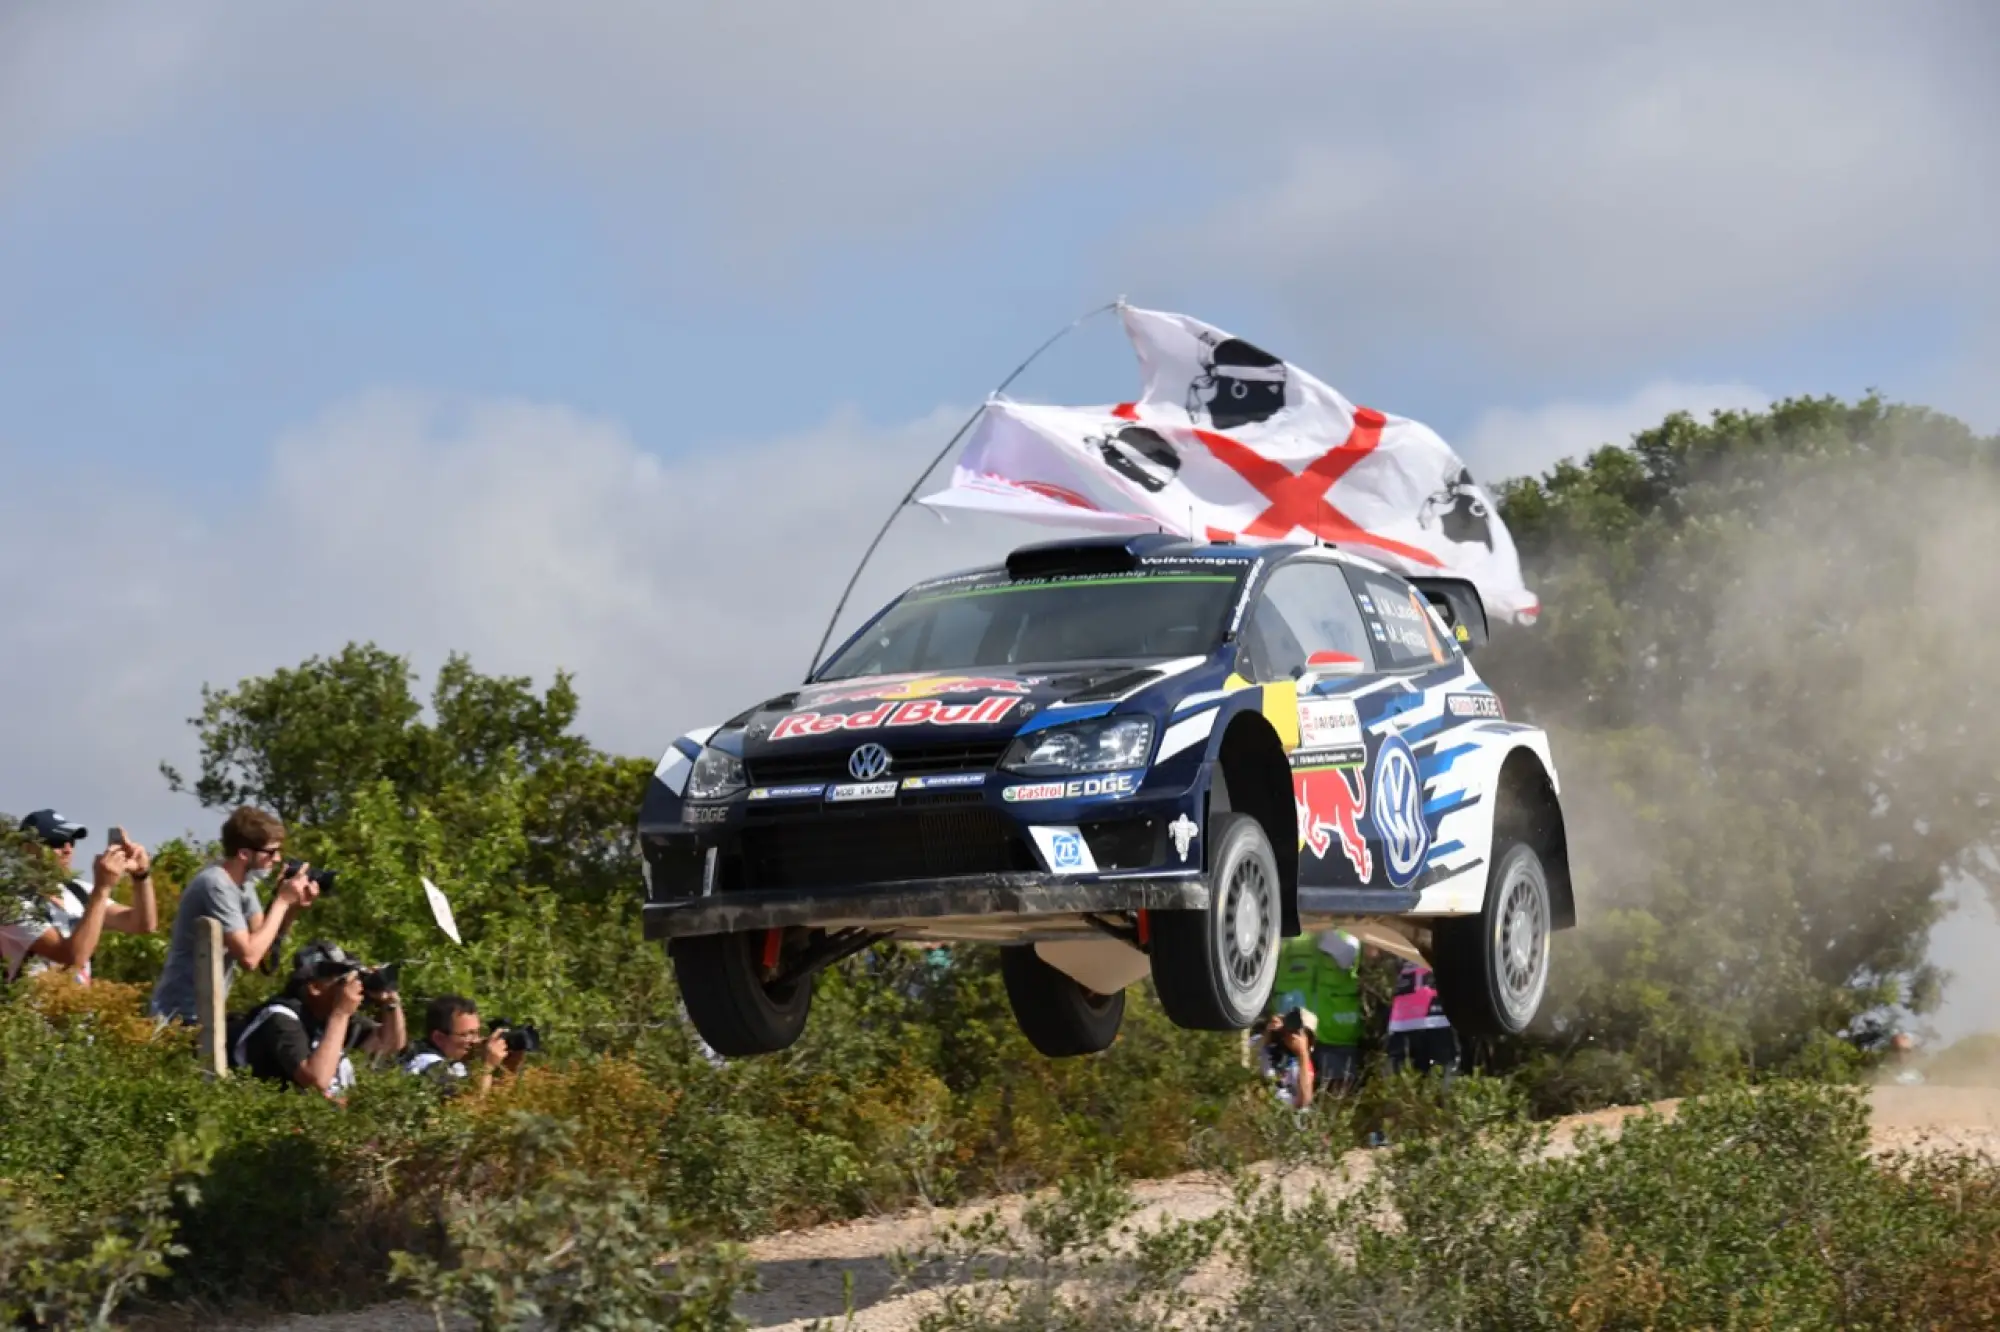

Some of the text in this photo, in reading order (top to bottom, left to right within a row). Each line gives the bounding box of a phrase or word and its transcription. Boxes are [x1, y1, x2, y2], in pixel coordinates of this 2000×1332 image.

[1141, 555, 1249, 566] Volkswagen
[767, 697, 1022, 740] Red Bull
[1018, 775, 1133, 799] Castrol EDGE
[695, 806, 729, 823] EDGE
